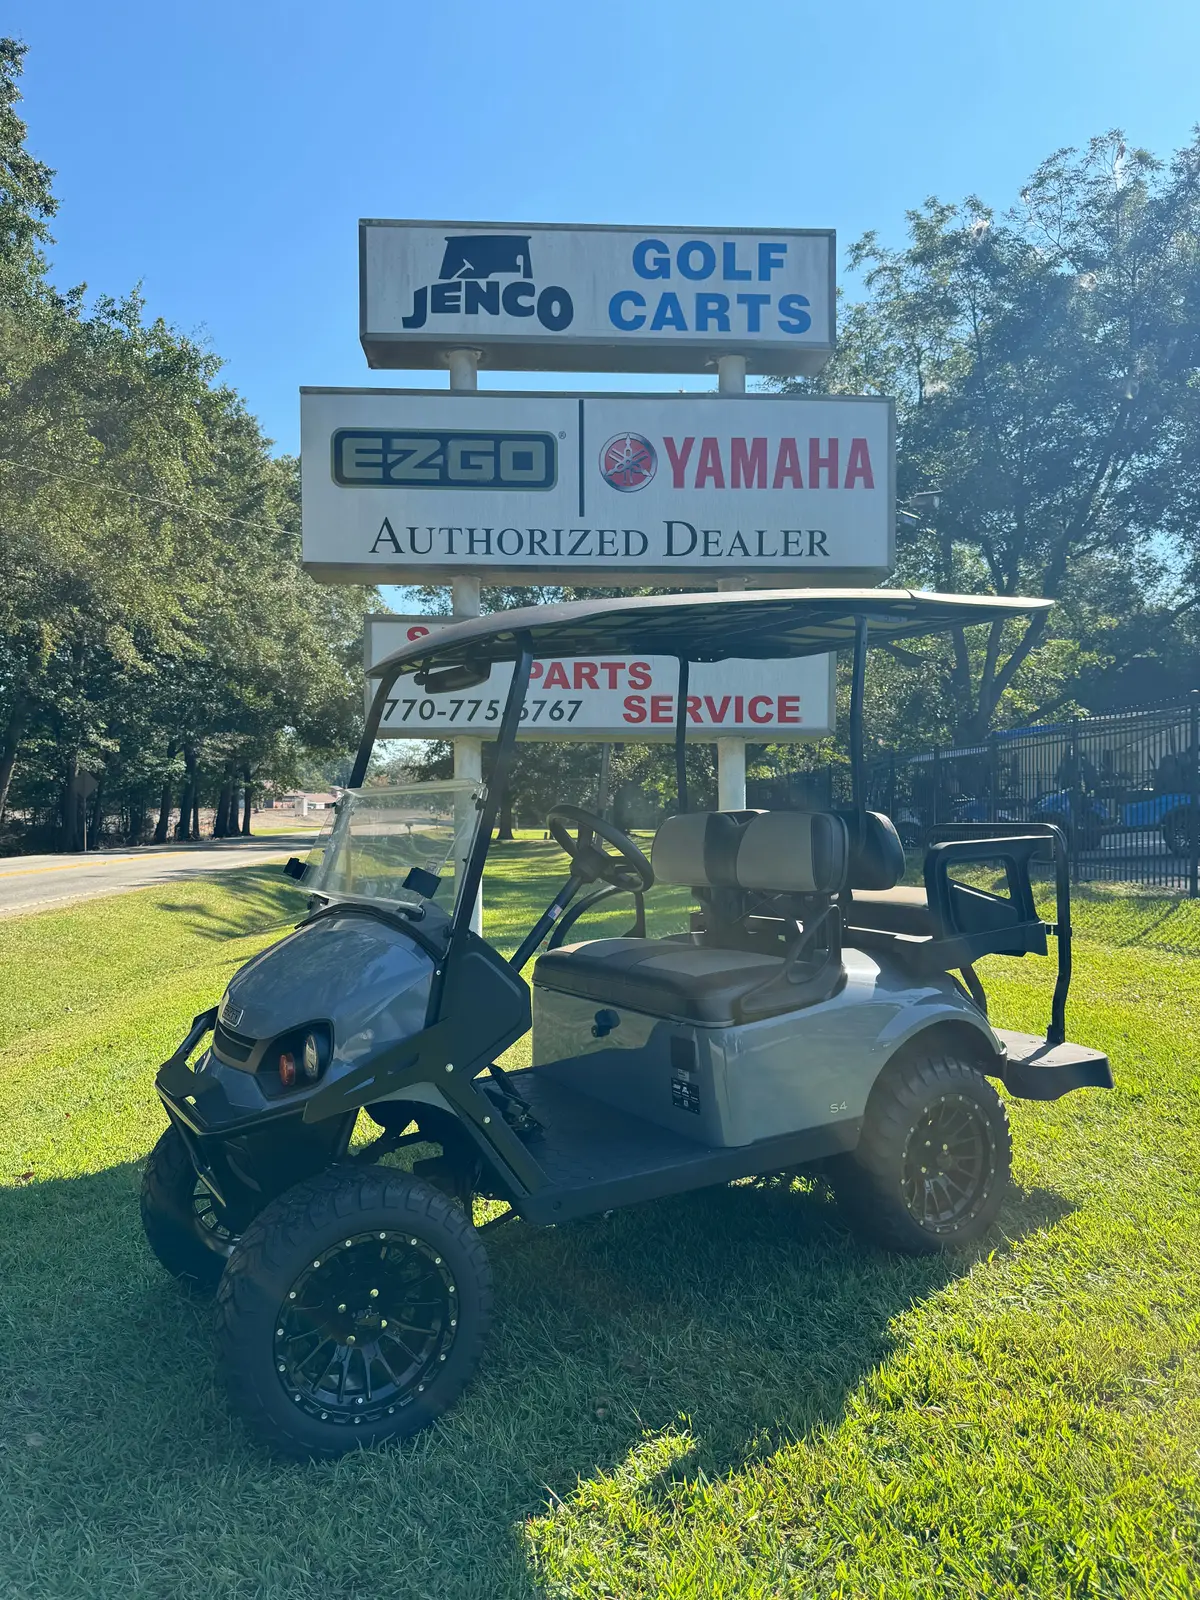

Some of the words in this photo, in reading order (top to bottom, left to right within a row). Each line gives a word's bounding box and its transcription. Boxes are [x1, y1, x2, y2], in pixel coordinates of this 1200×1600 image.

[632, 239, 787, 281] GOLF
[402, 281, 574, 332] JENCO
[608, 290, 811, 334] CARTS
[342, 437, 546, 482] EZGO
[662, 436, 875, 490] YAMAHA
[369, 517, 649, 557] AUTHORIZED
[663, 520, 831, 558] DEALER
[383, 698, 584, 723] 770-7756767
[622, 694, 803, 724] SERVICE
[830, 1101, 848, 1114] S4
